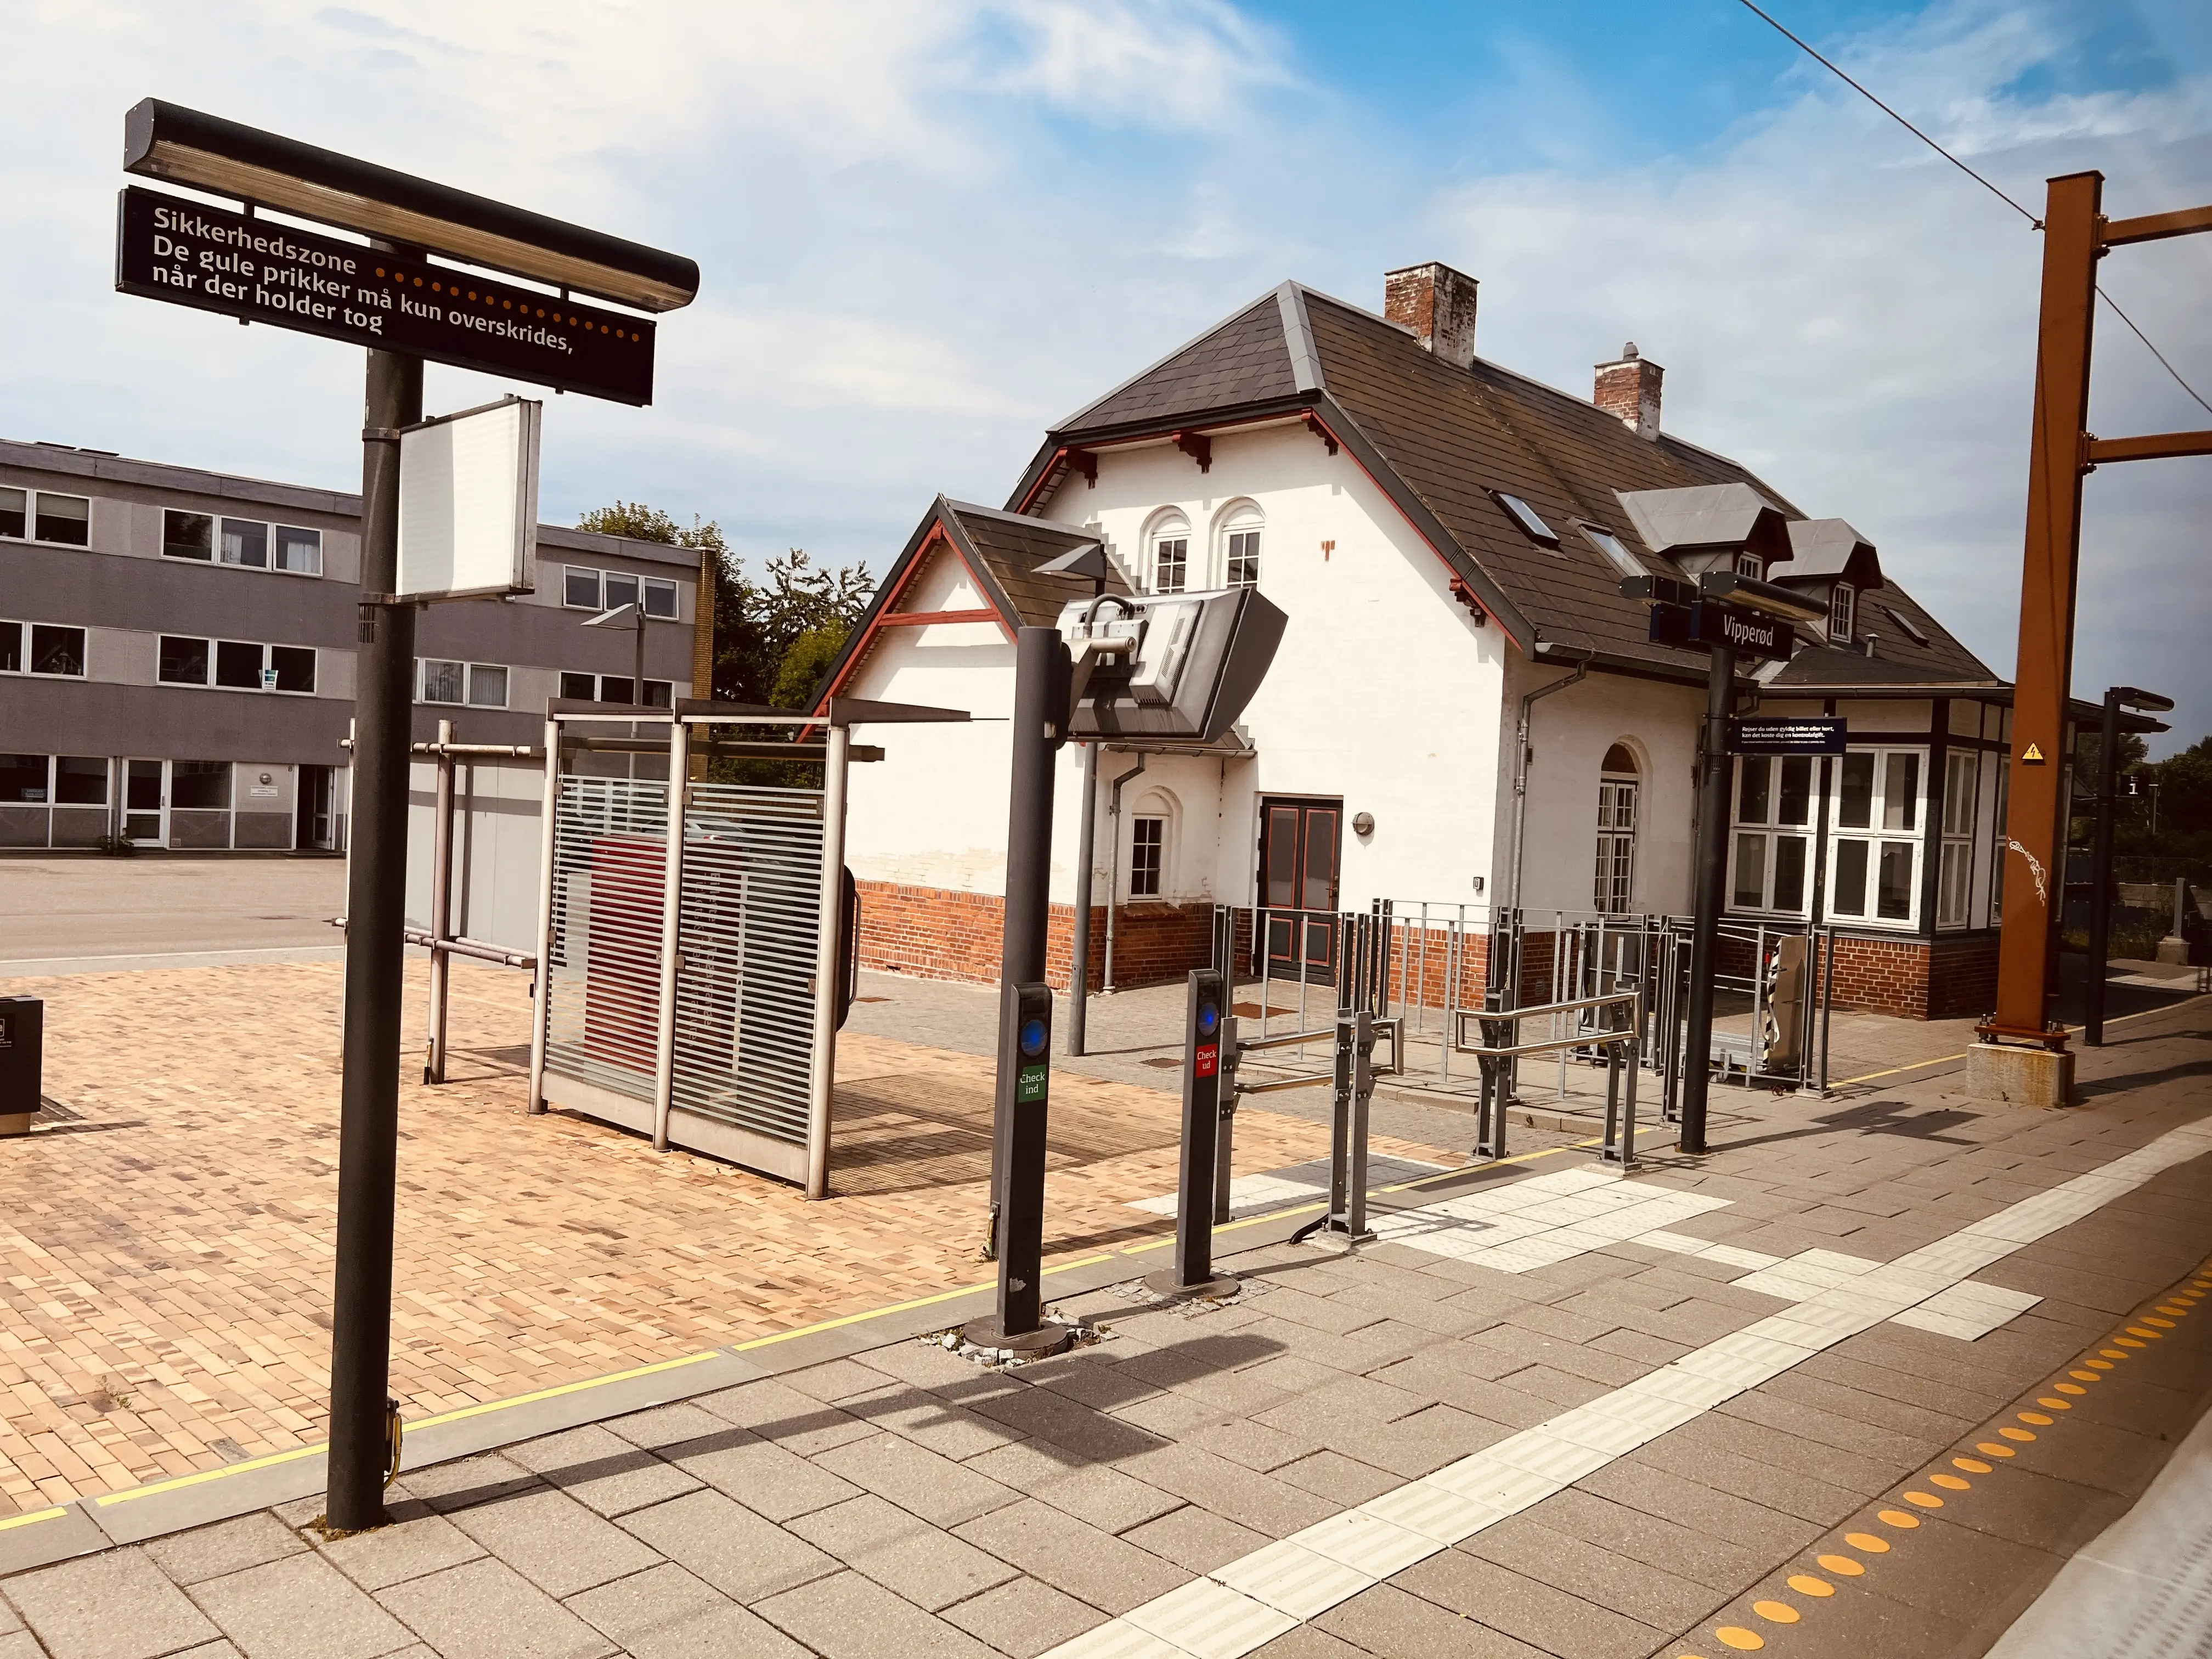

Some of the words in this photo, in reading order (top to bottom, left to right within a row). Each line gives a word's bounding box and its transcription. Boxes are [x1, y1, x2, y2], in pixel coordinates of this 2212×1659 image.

[154, 207, 356, 274] Sikkerhedszone
[153, 264, 197, 289] når
[205, 275, 248, 300] der
[256, 284, 336, 320] holder
[343, 307, 382, 335] tog
[154, 234, 189, 262] De
[199, 250, 255, 276] gule
[264, 266, 351, 298] prikker
[358, 288, 392, 309] må
[401, 294, 441, 321] kun
[449, 311, 573, 355] overskrides,
[1724, 614, 1774, 647] Vipperød
[2128, 783, 2138, 795] 1
[1197, 1049, 1217, 1060] Check
[1202, 1060, 1210, 1069] ud
[1020, 1071, 1045, 1084] Check
[1025, 1084, 1039, 1094] ind
